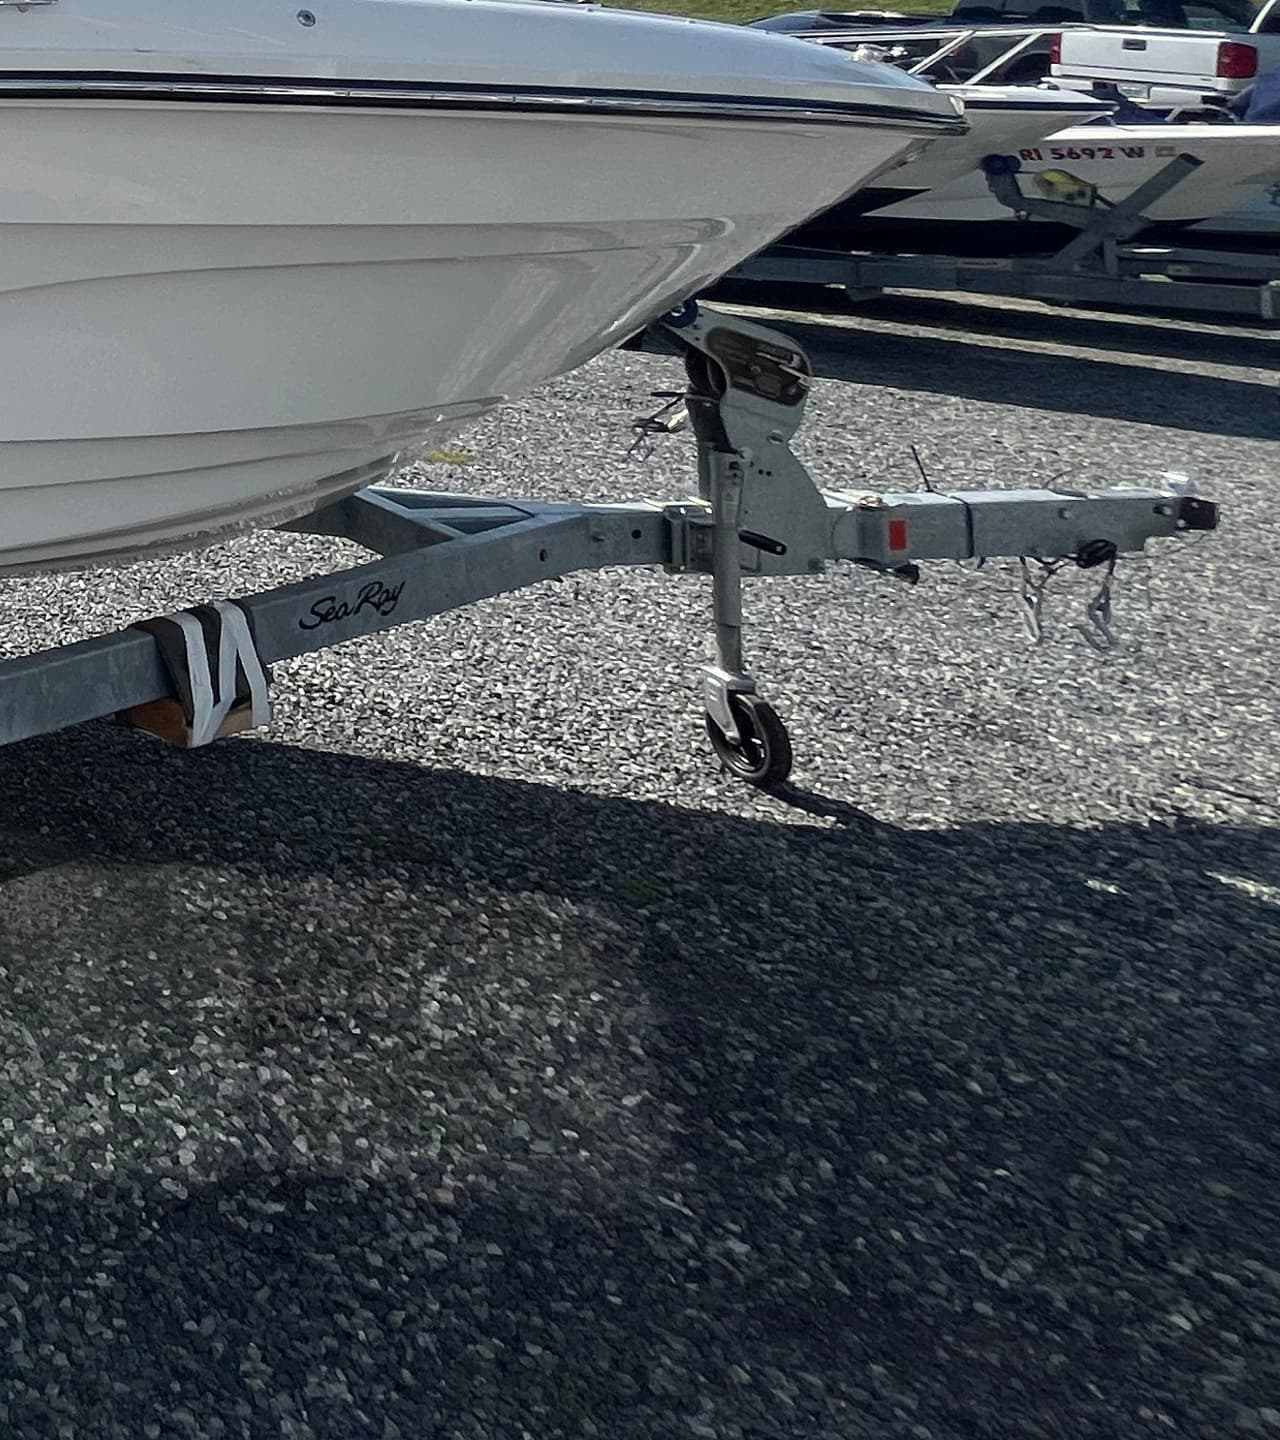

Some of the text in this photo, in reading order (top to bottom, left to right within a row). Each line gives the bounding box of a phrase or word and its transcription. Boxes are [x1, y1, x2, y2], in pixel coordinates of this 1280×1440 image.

[1018, 147, 1044, 161] RI
[1050, 147, 1115, 160] 5692
[1118, 146, 1145, 159] W
[298, 580, 406, 630] Sea Ray
